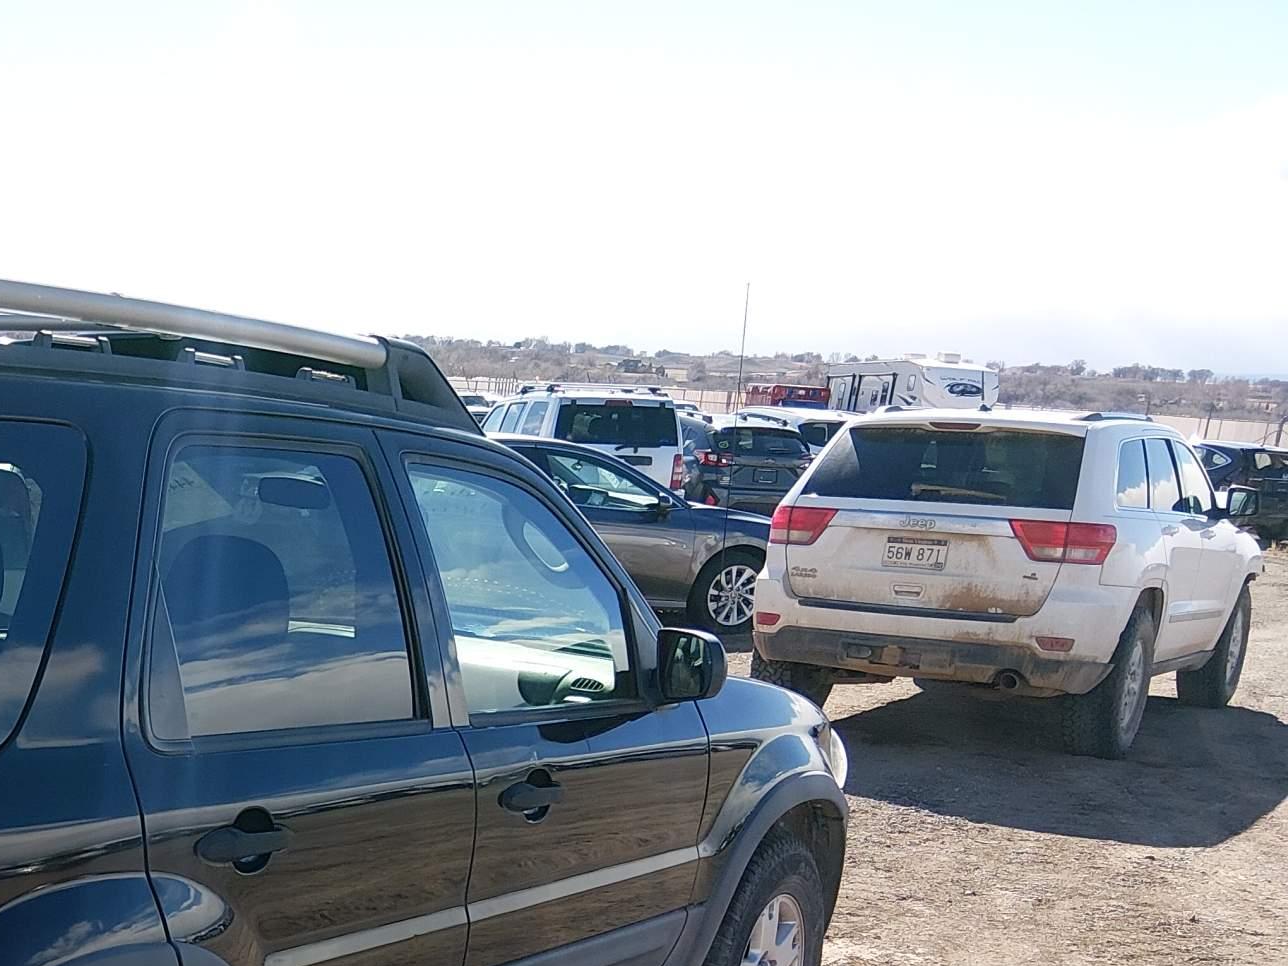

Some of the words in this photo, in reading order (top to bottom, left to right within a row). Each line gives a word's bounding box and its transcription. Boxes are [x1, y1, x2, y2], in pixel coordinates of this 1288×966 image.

[899, 515, 936, 530] Jeep
[887, 545, 913, 561] 56W
[916, 547, 941, 564] 871
